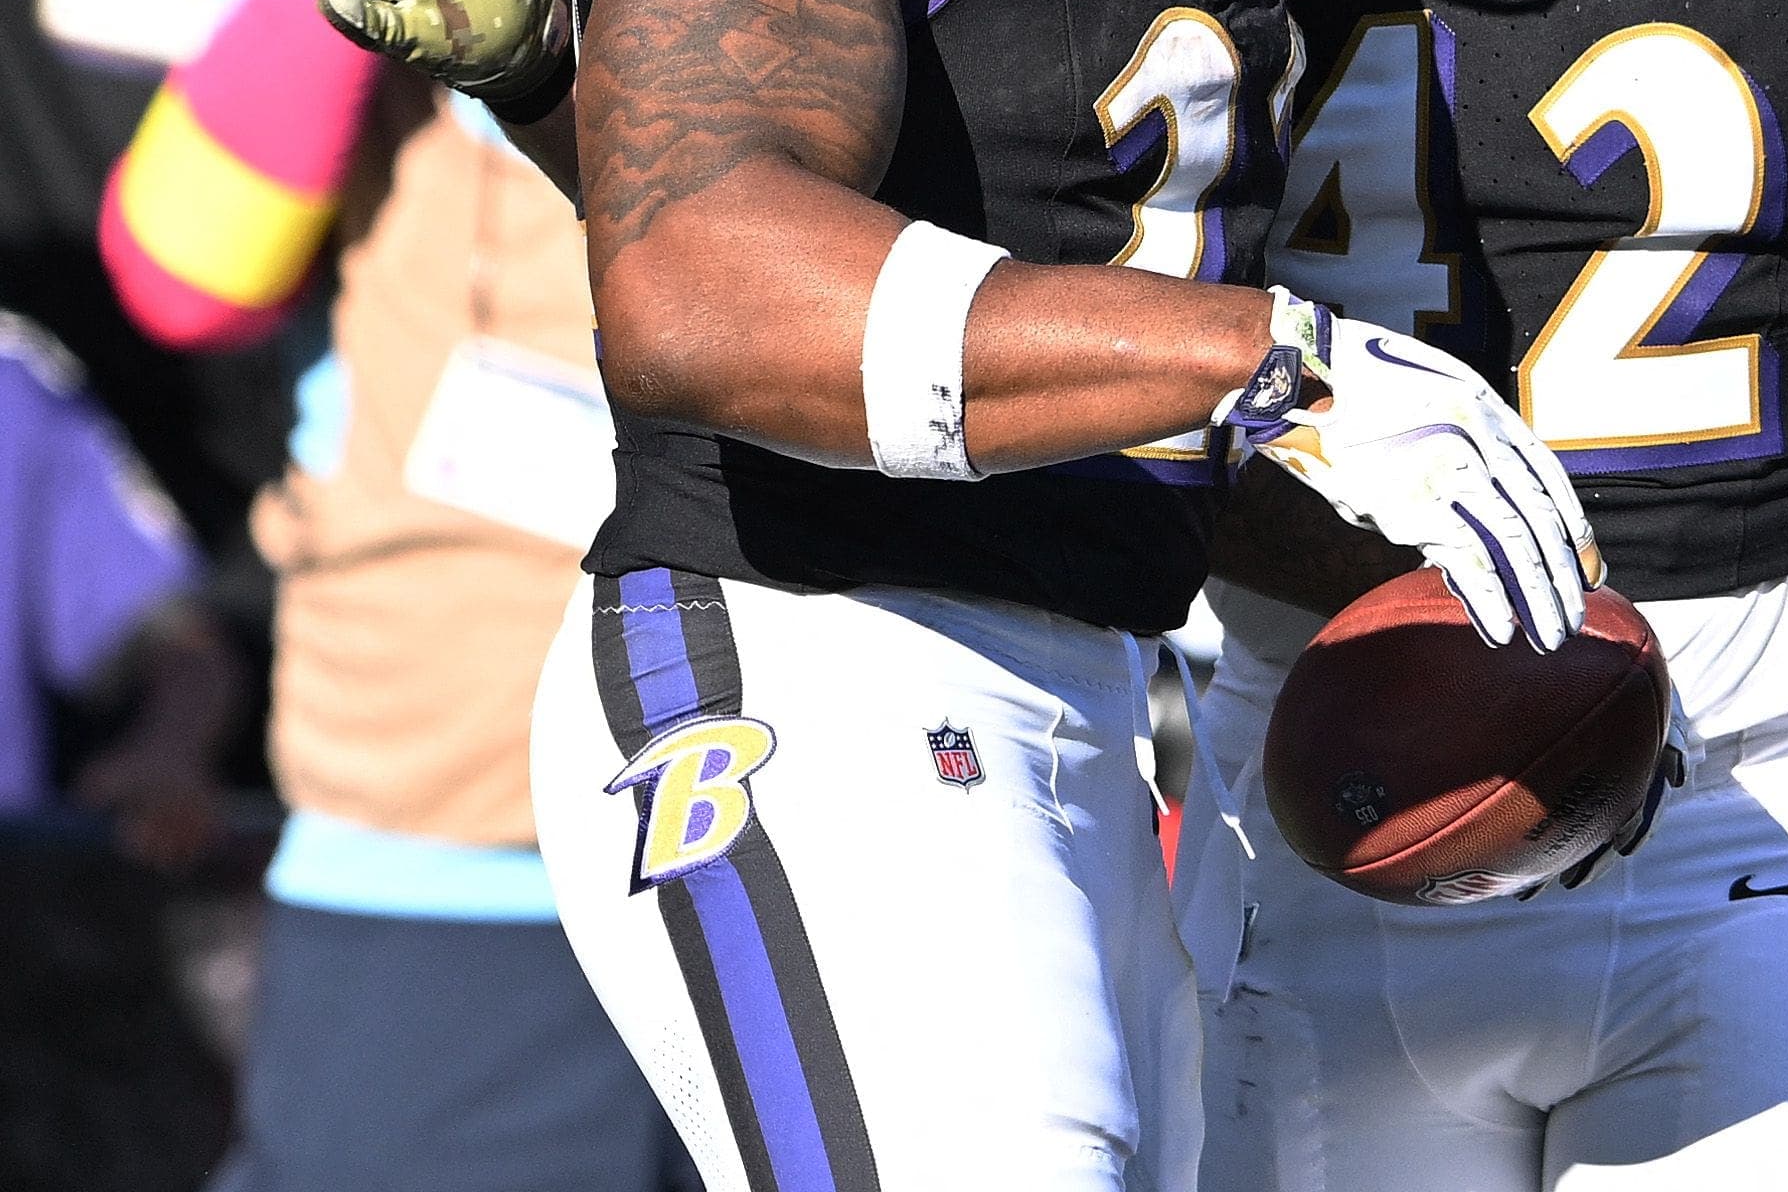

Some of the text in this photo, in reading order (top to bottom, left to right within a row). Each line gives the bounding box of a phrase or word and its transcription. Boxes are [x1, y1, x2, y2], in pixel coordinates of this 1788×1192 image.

[1265, 8, 1764, 452] 42
[603, 714, 777, 897] B
[936, 751, 978, 780] NFL
